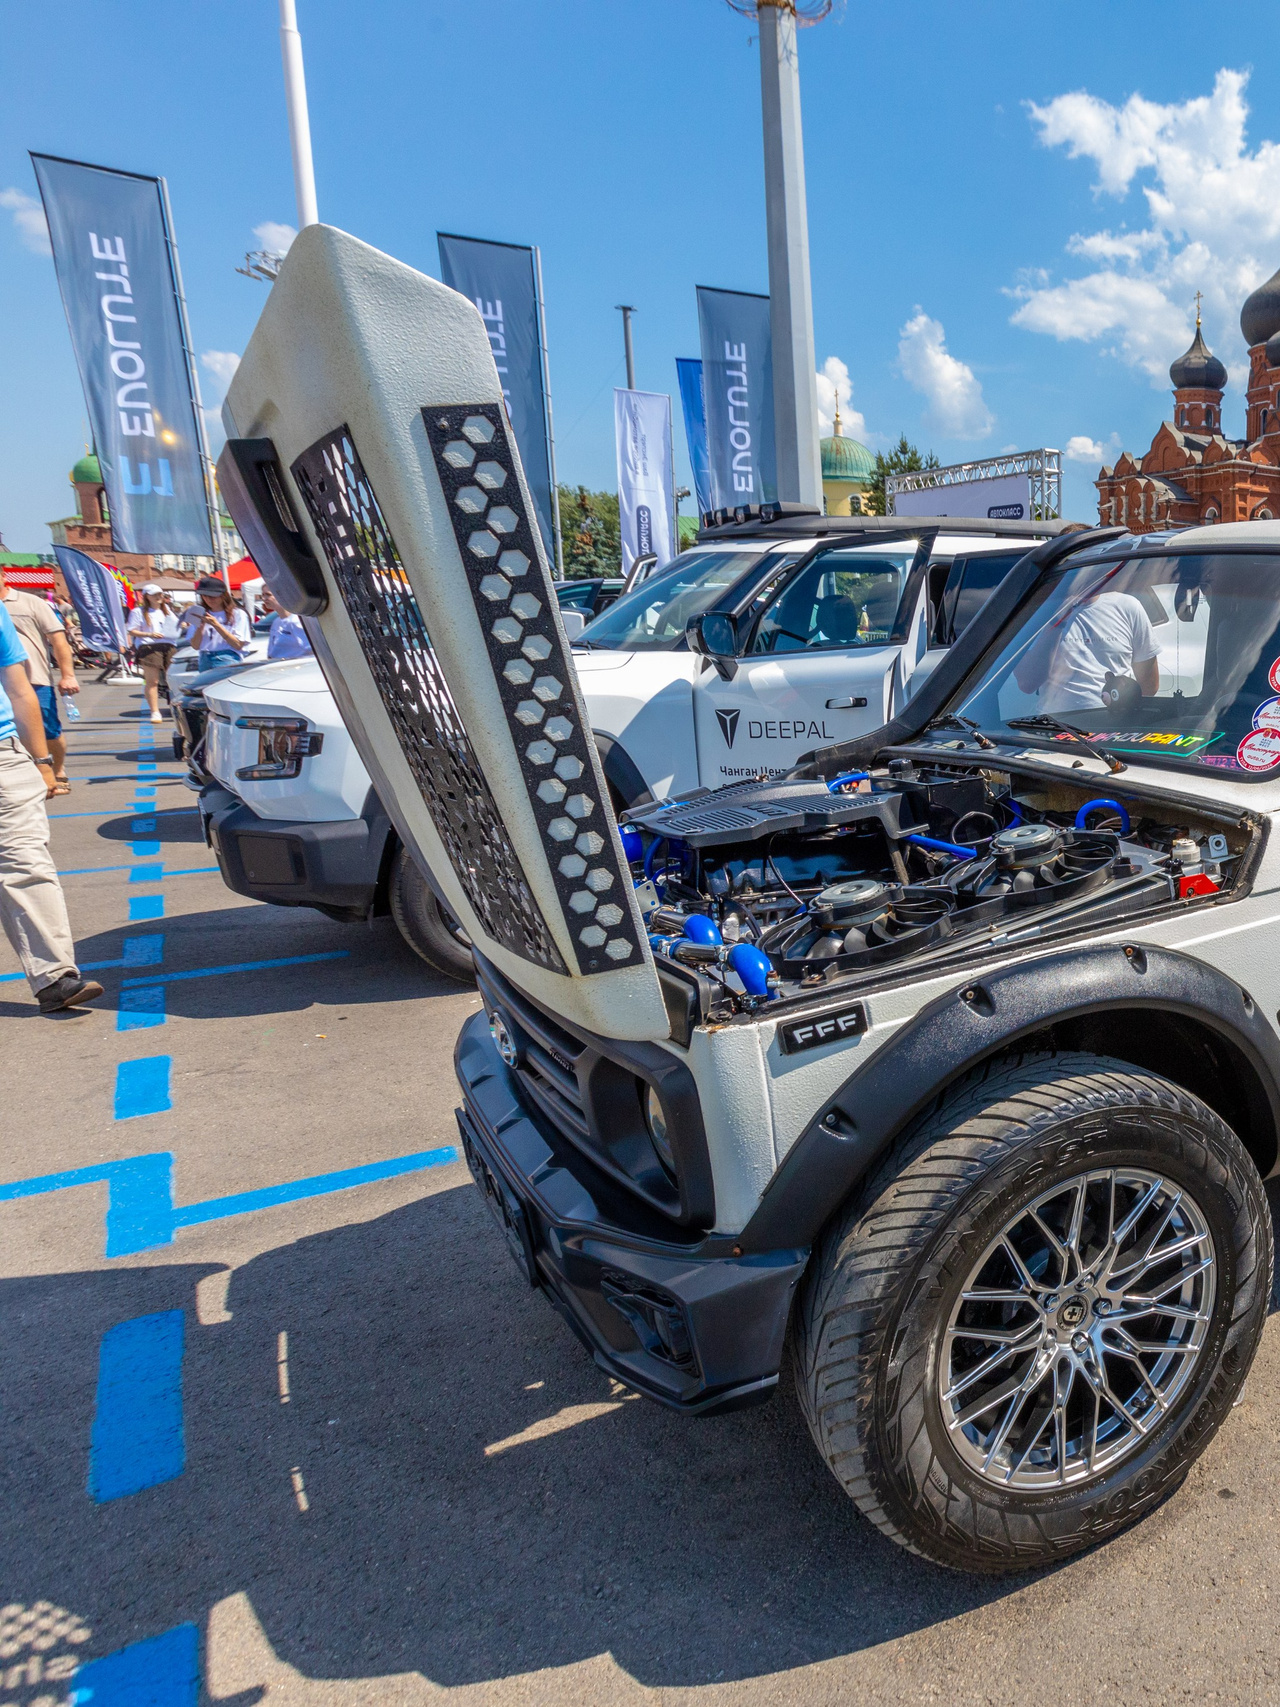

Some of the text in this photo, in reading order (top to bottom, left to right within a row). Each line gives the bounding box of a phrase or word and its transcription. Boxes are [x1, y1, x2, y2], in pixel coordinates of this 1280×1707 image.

[748, 721, 834, 738] DEEPAL
[720, 766, 758, 776] Чанган
[792, 1013, 857, 1044] FFF
